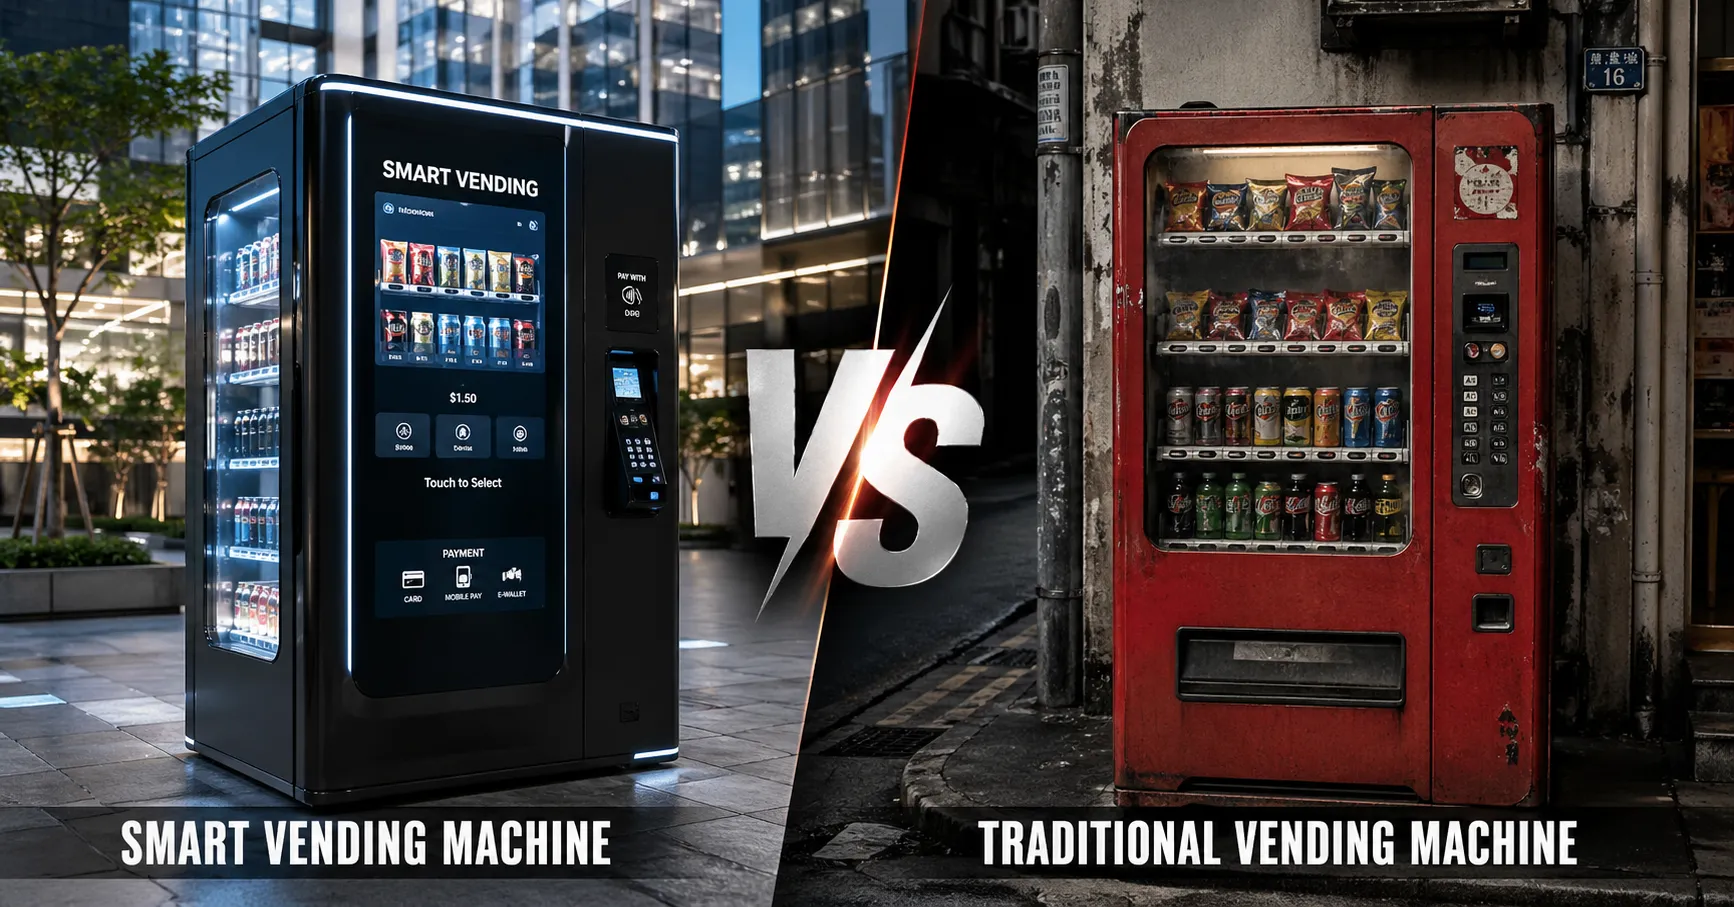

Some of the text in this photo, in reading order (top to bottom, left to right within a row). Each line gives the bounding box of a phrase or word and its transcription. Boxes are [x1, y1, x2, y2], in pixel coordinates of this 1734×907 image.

[1604, 67, 1625, 86] 16
[382, 159, 539, 198] SMART VENDING
[617, 271, 647, 282] PAY WITH
[449, 392, 477, 404] $1.50
[424, 477, 502, 488] Touch to Select
[442, 548, 485, 559] PAYMENT
[404, 595, 423, 603] CARD
[445, 592, 483, 601] MOBILE PAY
[497, 590, 527, 599] E-WALLET
